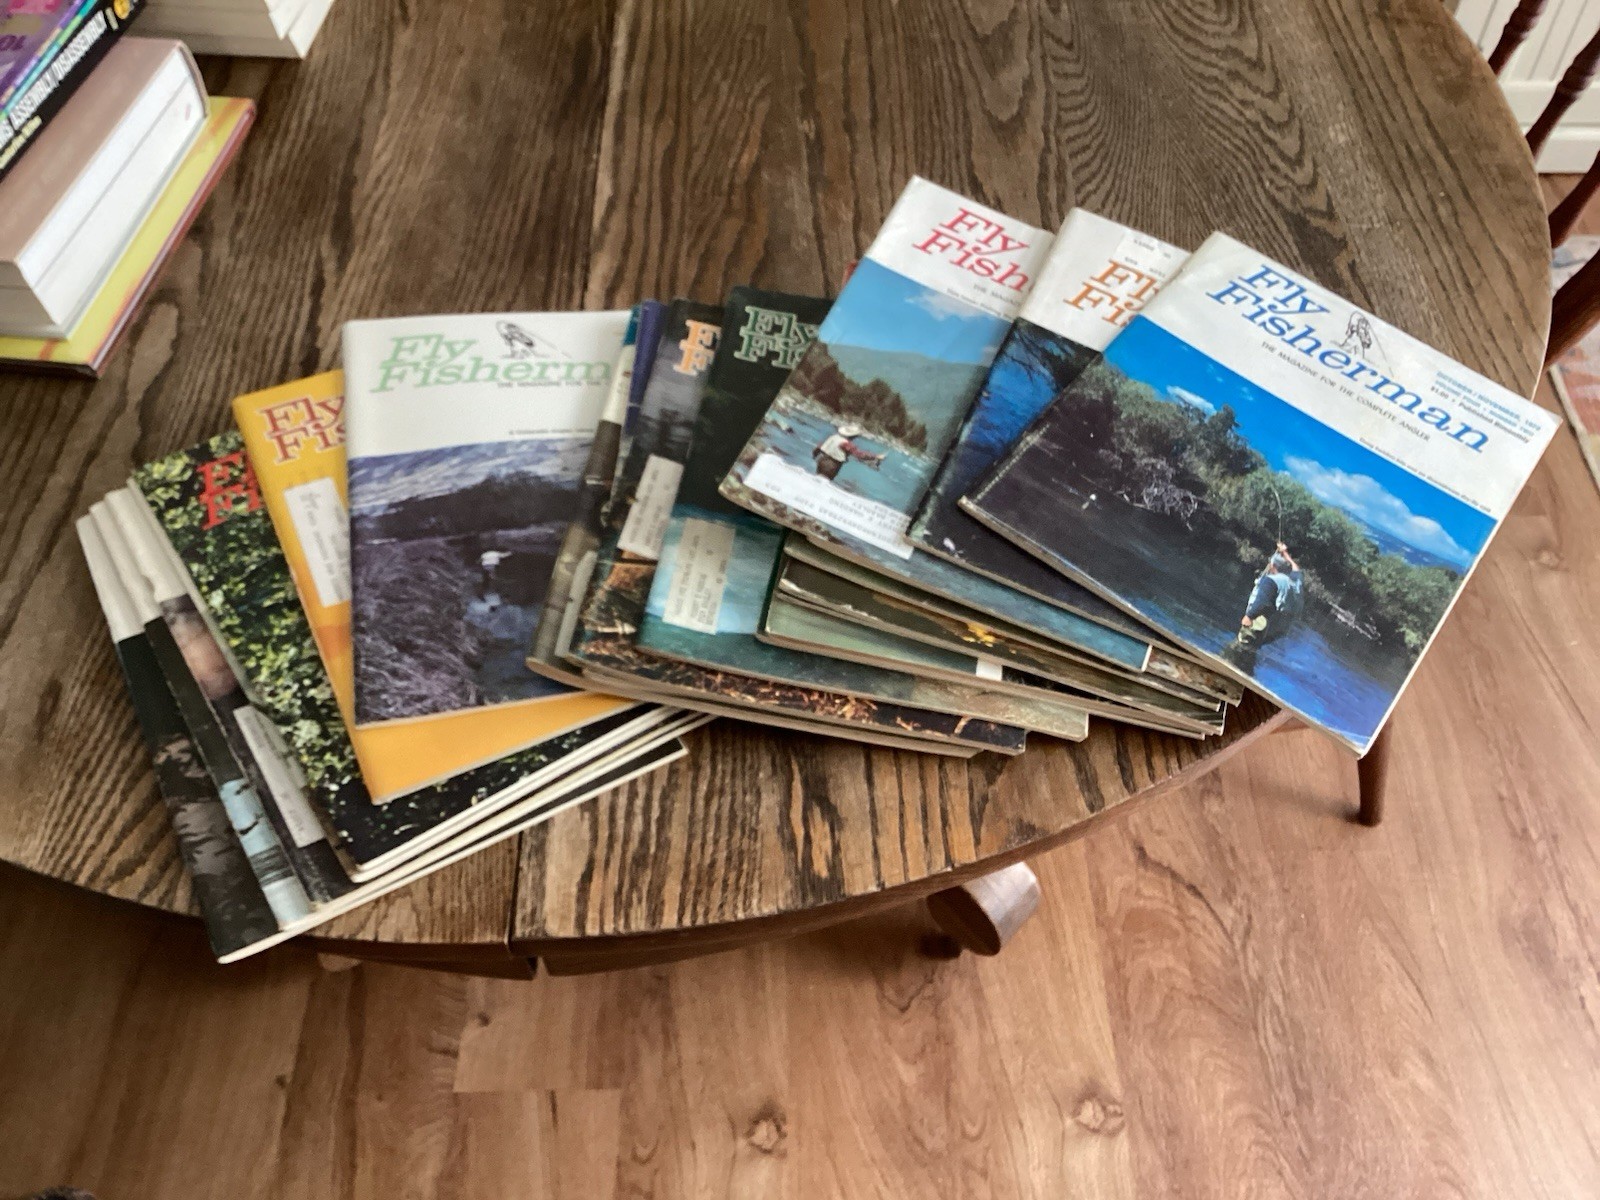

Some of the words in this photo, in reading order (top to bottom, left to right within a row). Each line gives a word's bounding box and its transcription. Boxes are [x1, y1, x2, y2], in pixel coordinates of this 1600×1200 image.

[939, 207, 1030, 255] Fly
[912, 229, 1036, 294] Fish
[1237, 263, 1331, 315] Fly
[369, 356, 613, 393] Fisherm
[386, 334, 479, 370] Fly
[1205, 280, 1489, 454] Fisherman
[255, 394, 346, 434] Fly
[1261, 341, 1277, 354] THE
[1277, 352, 1318, 378] MAGAZINE
[1320, 375, 1336, 388] FOR
[1339, 386, 1355, 398] THE
[1356, 395, 1397, 422] COMPLETE
[1399, 420, 1431, 443] ANGLER
